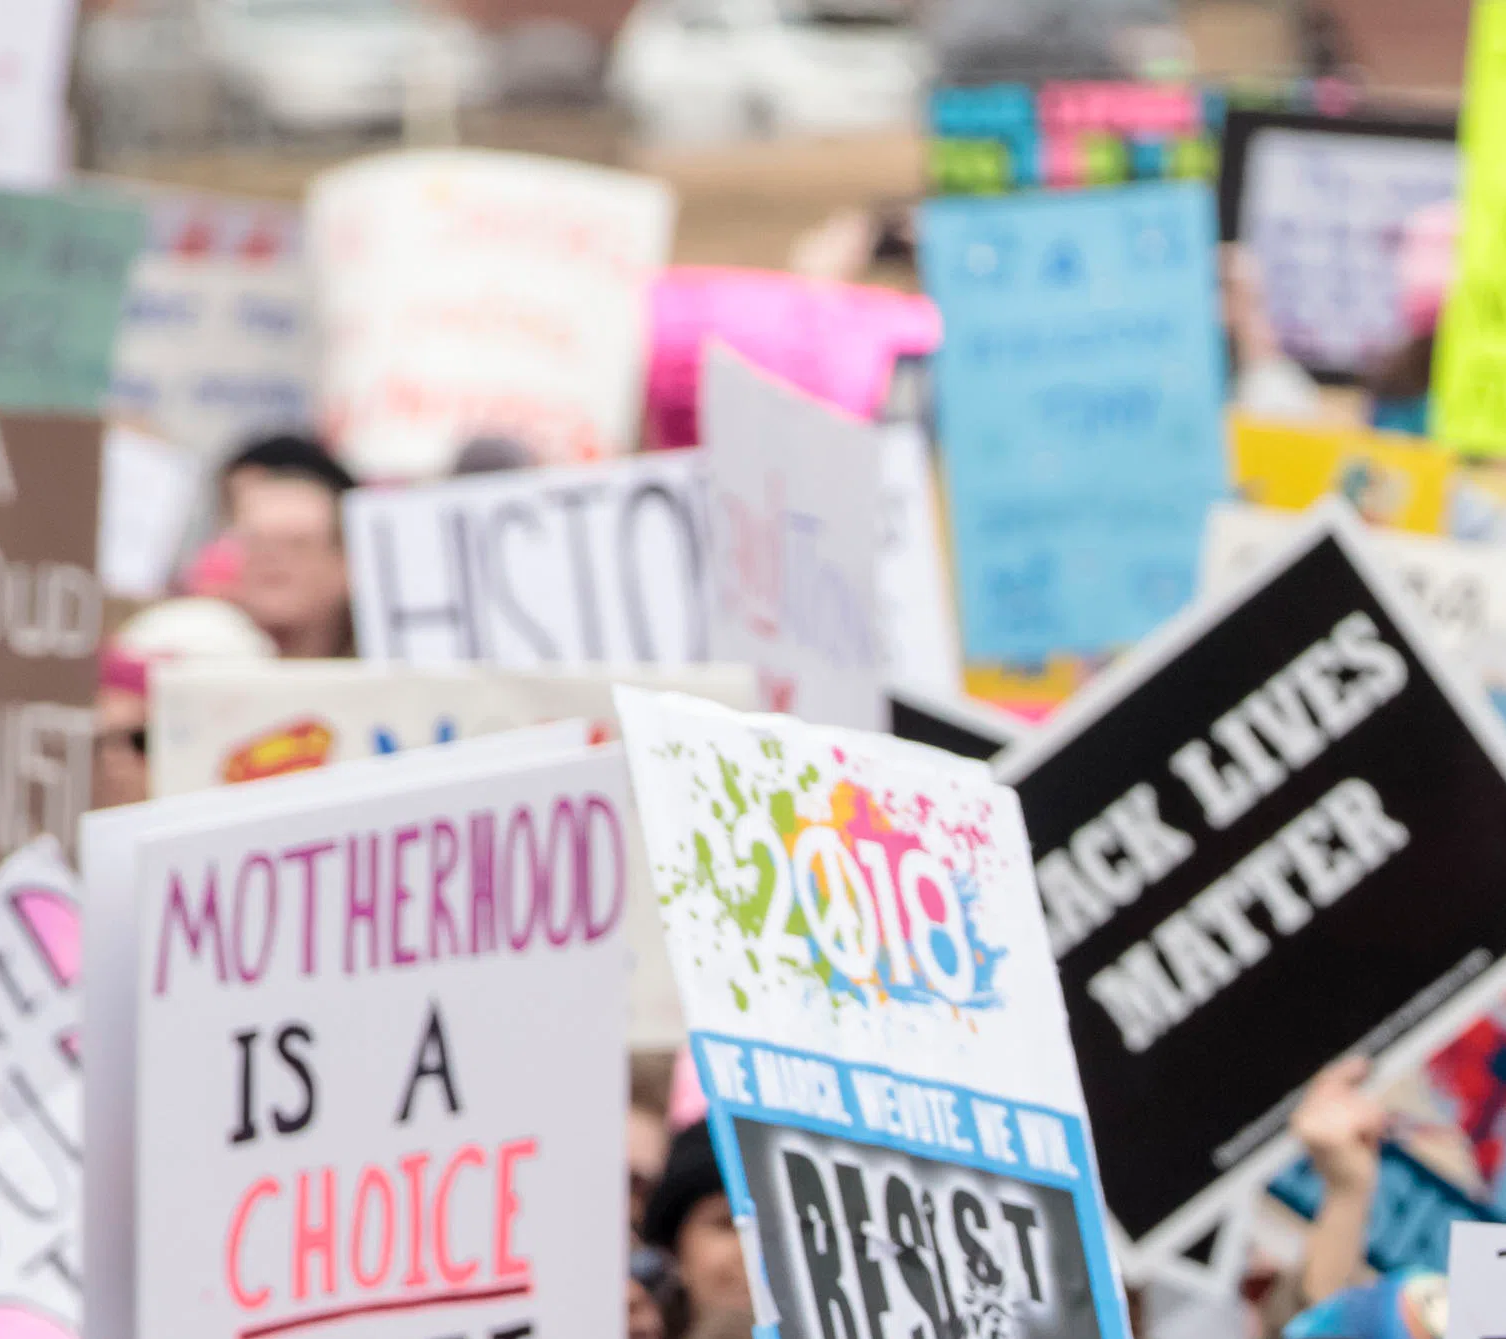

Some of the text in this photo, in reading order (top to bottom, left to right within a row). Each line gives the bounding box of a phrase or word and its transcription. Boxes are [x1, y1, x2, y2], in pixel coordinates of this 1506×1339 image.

[1168, 608, 1410, 832] LIVES
[154, 793, 624, 998] MOTHERHOOD
[739, 818, 974, 1006] 2018
[1086, 776, 1412, 1053] MATTER
[226, 1000, 460, 1146] IS A
[225, 1138, 539, 1310] CHOICE
